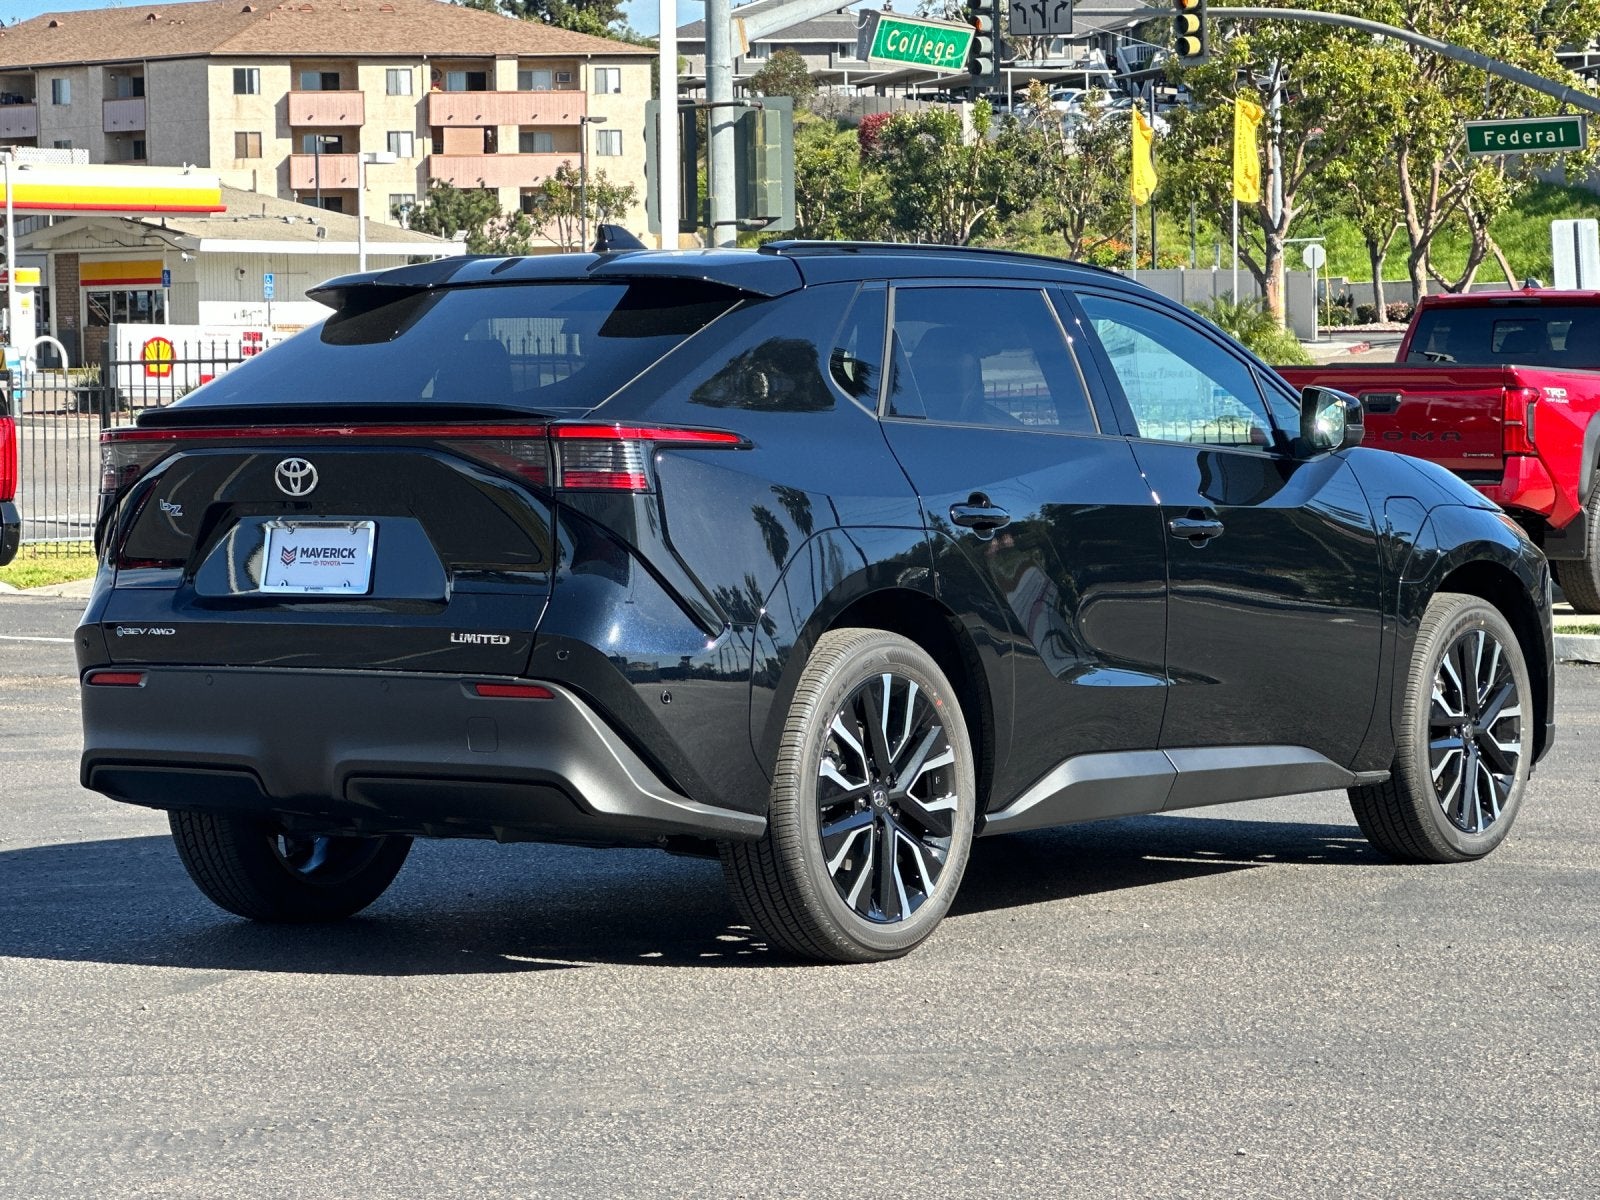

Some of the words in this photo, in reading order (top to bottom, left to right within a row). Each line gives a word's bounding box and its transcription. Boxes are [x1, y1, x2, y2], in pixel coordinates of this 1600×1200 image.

[887, 29, 955, 65] College
[1483, 127, 1564, 146] Federal
[1543, 387, 1567, 398] TRD
[299, 547, 357, 559] MAVERICK
[147, 627, 176, 635] AWD
[450, 632, 511, 645] LIMITED
